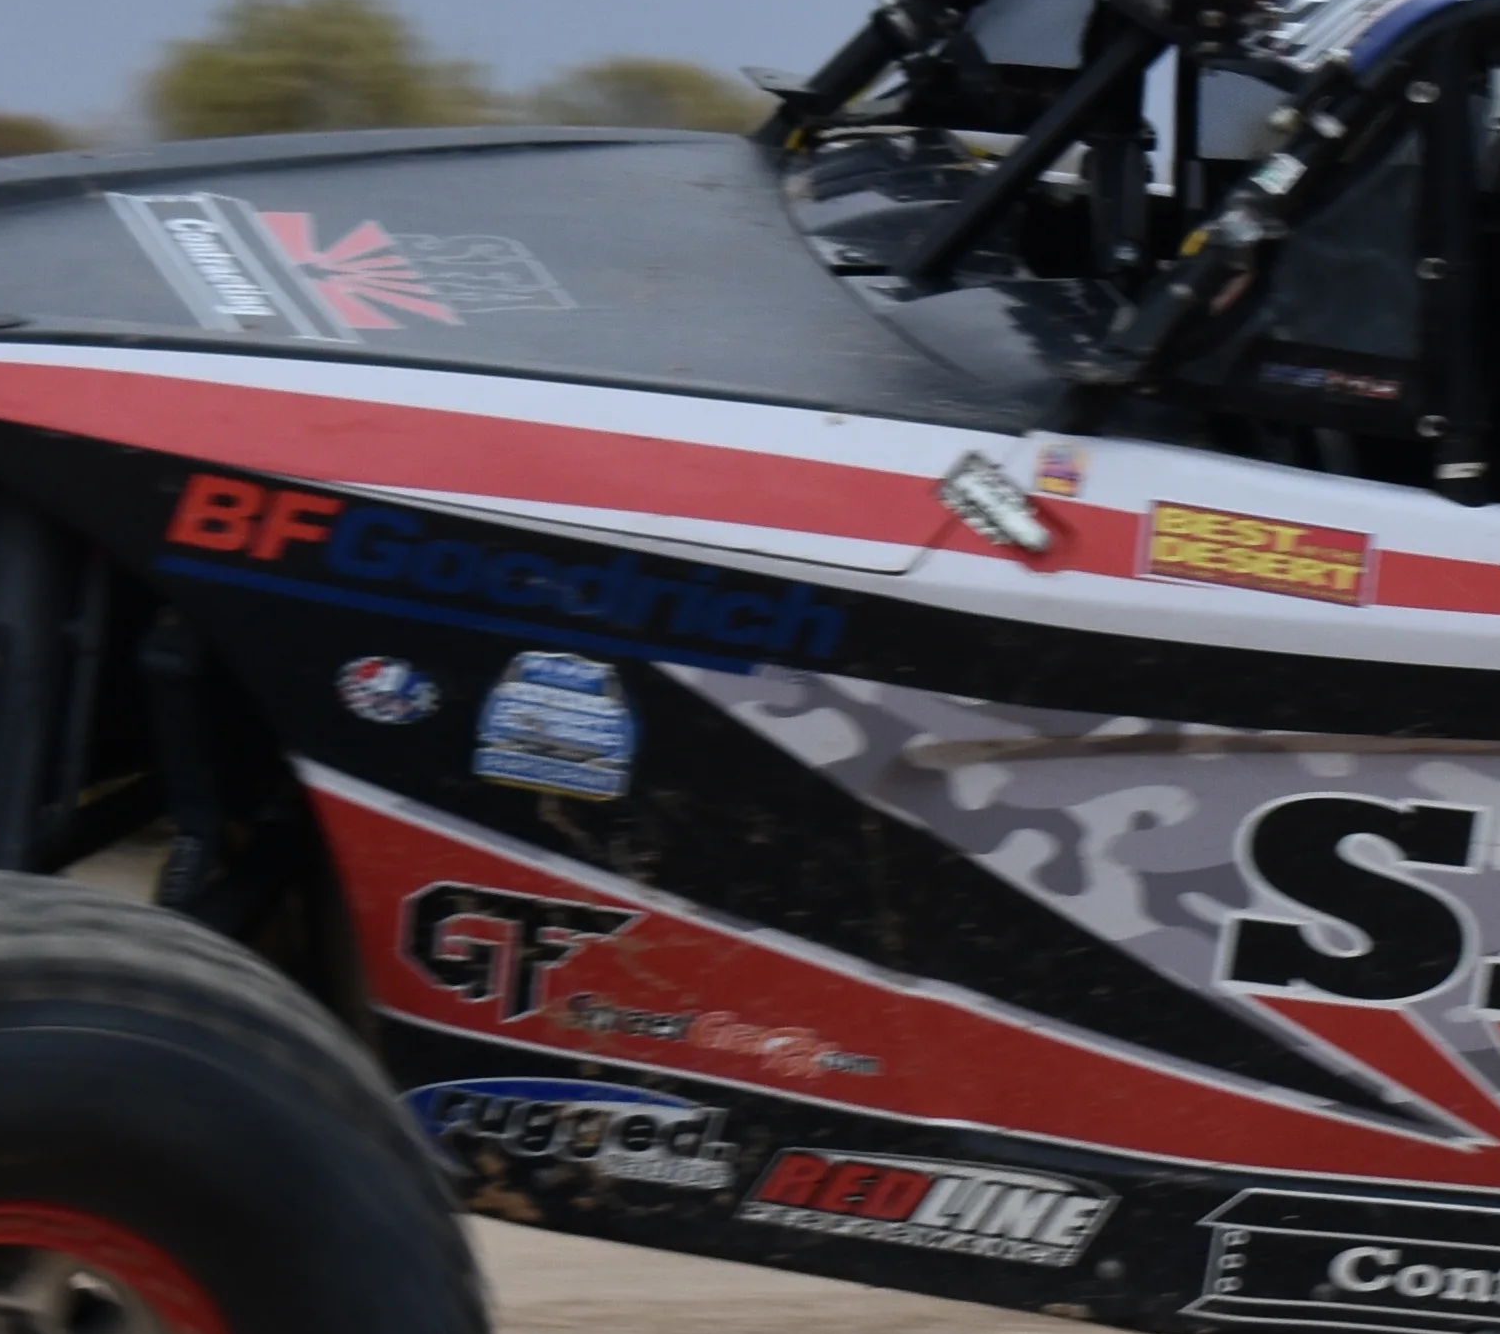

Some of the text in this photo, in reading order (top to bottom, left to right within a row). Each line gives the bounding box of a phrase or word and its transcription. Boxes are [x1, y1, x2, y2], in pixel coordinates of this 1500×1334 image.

[1153, 506, 1312, 553] BEST
[165, 475, 848, 657] BFGoodrich
[1152, 535, 1366, 591] DESERT
